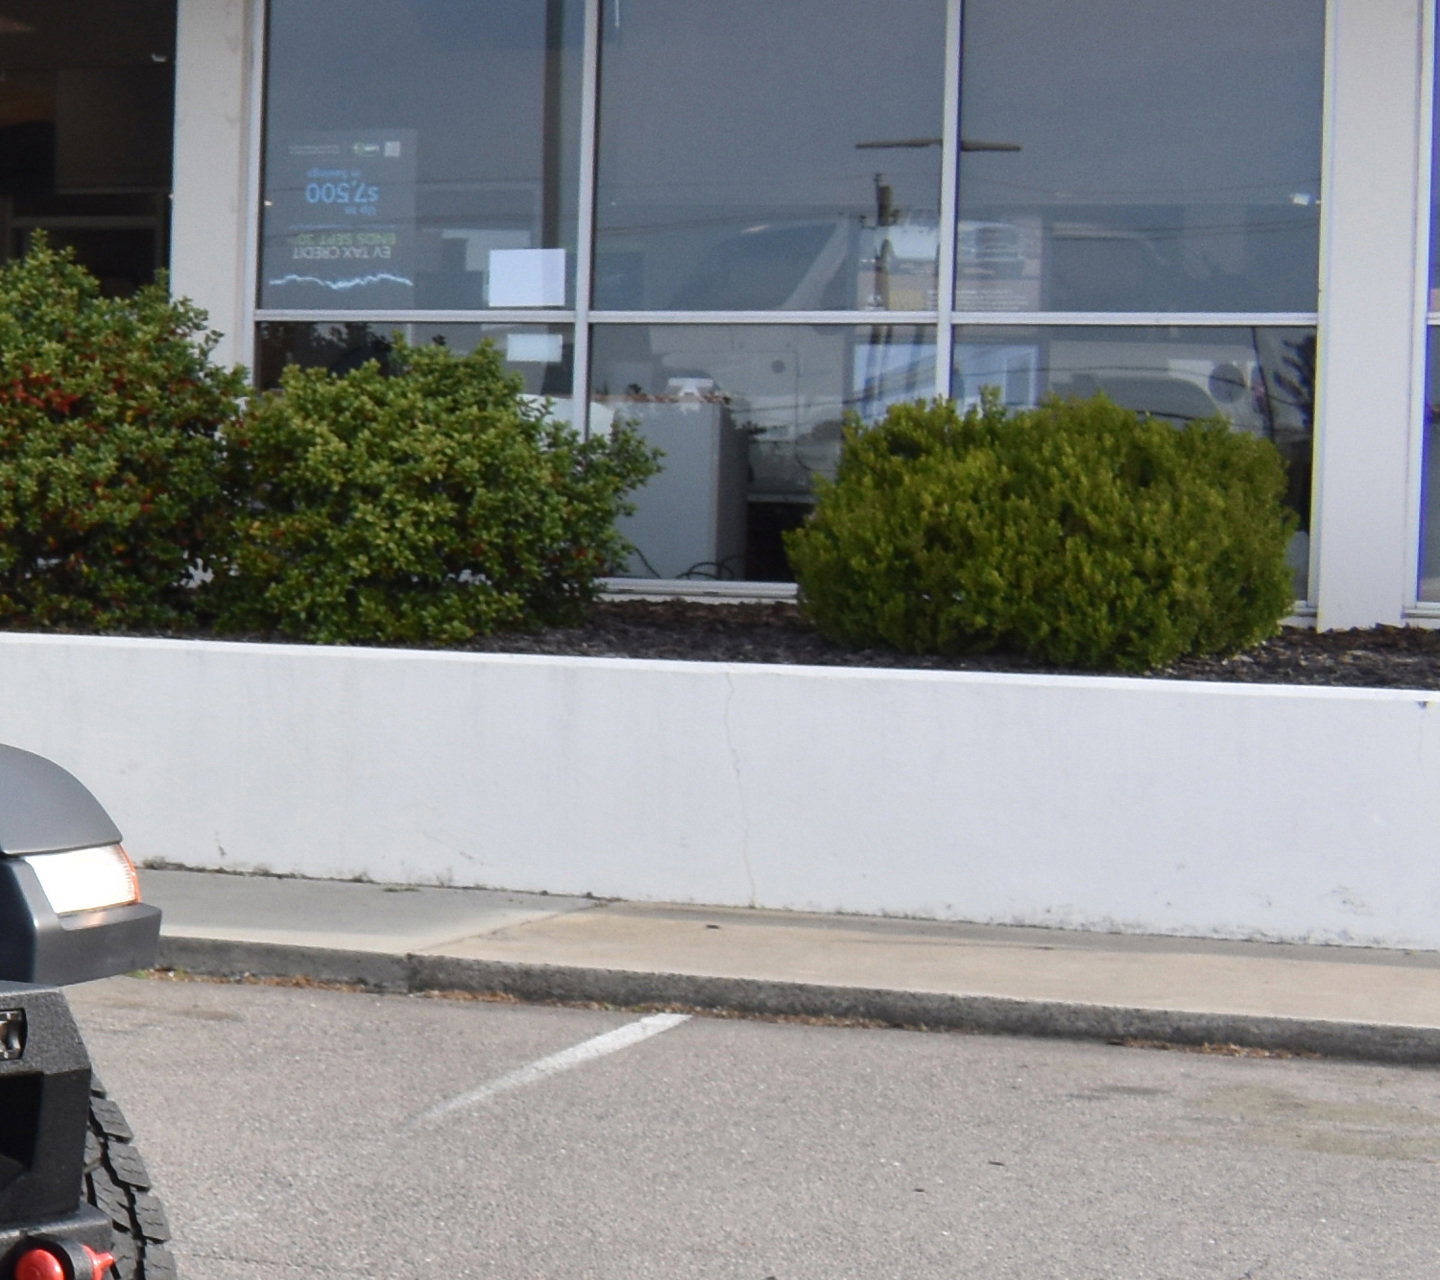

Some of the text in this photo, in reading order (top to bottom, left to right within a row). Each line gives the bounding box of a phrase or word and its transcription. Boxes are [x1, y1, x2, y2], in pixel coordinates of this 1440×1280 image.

[304, 179, 380, 205] $7,500
[291, 245, 392, 260] EV TAX CREDIT
